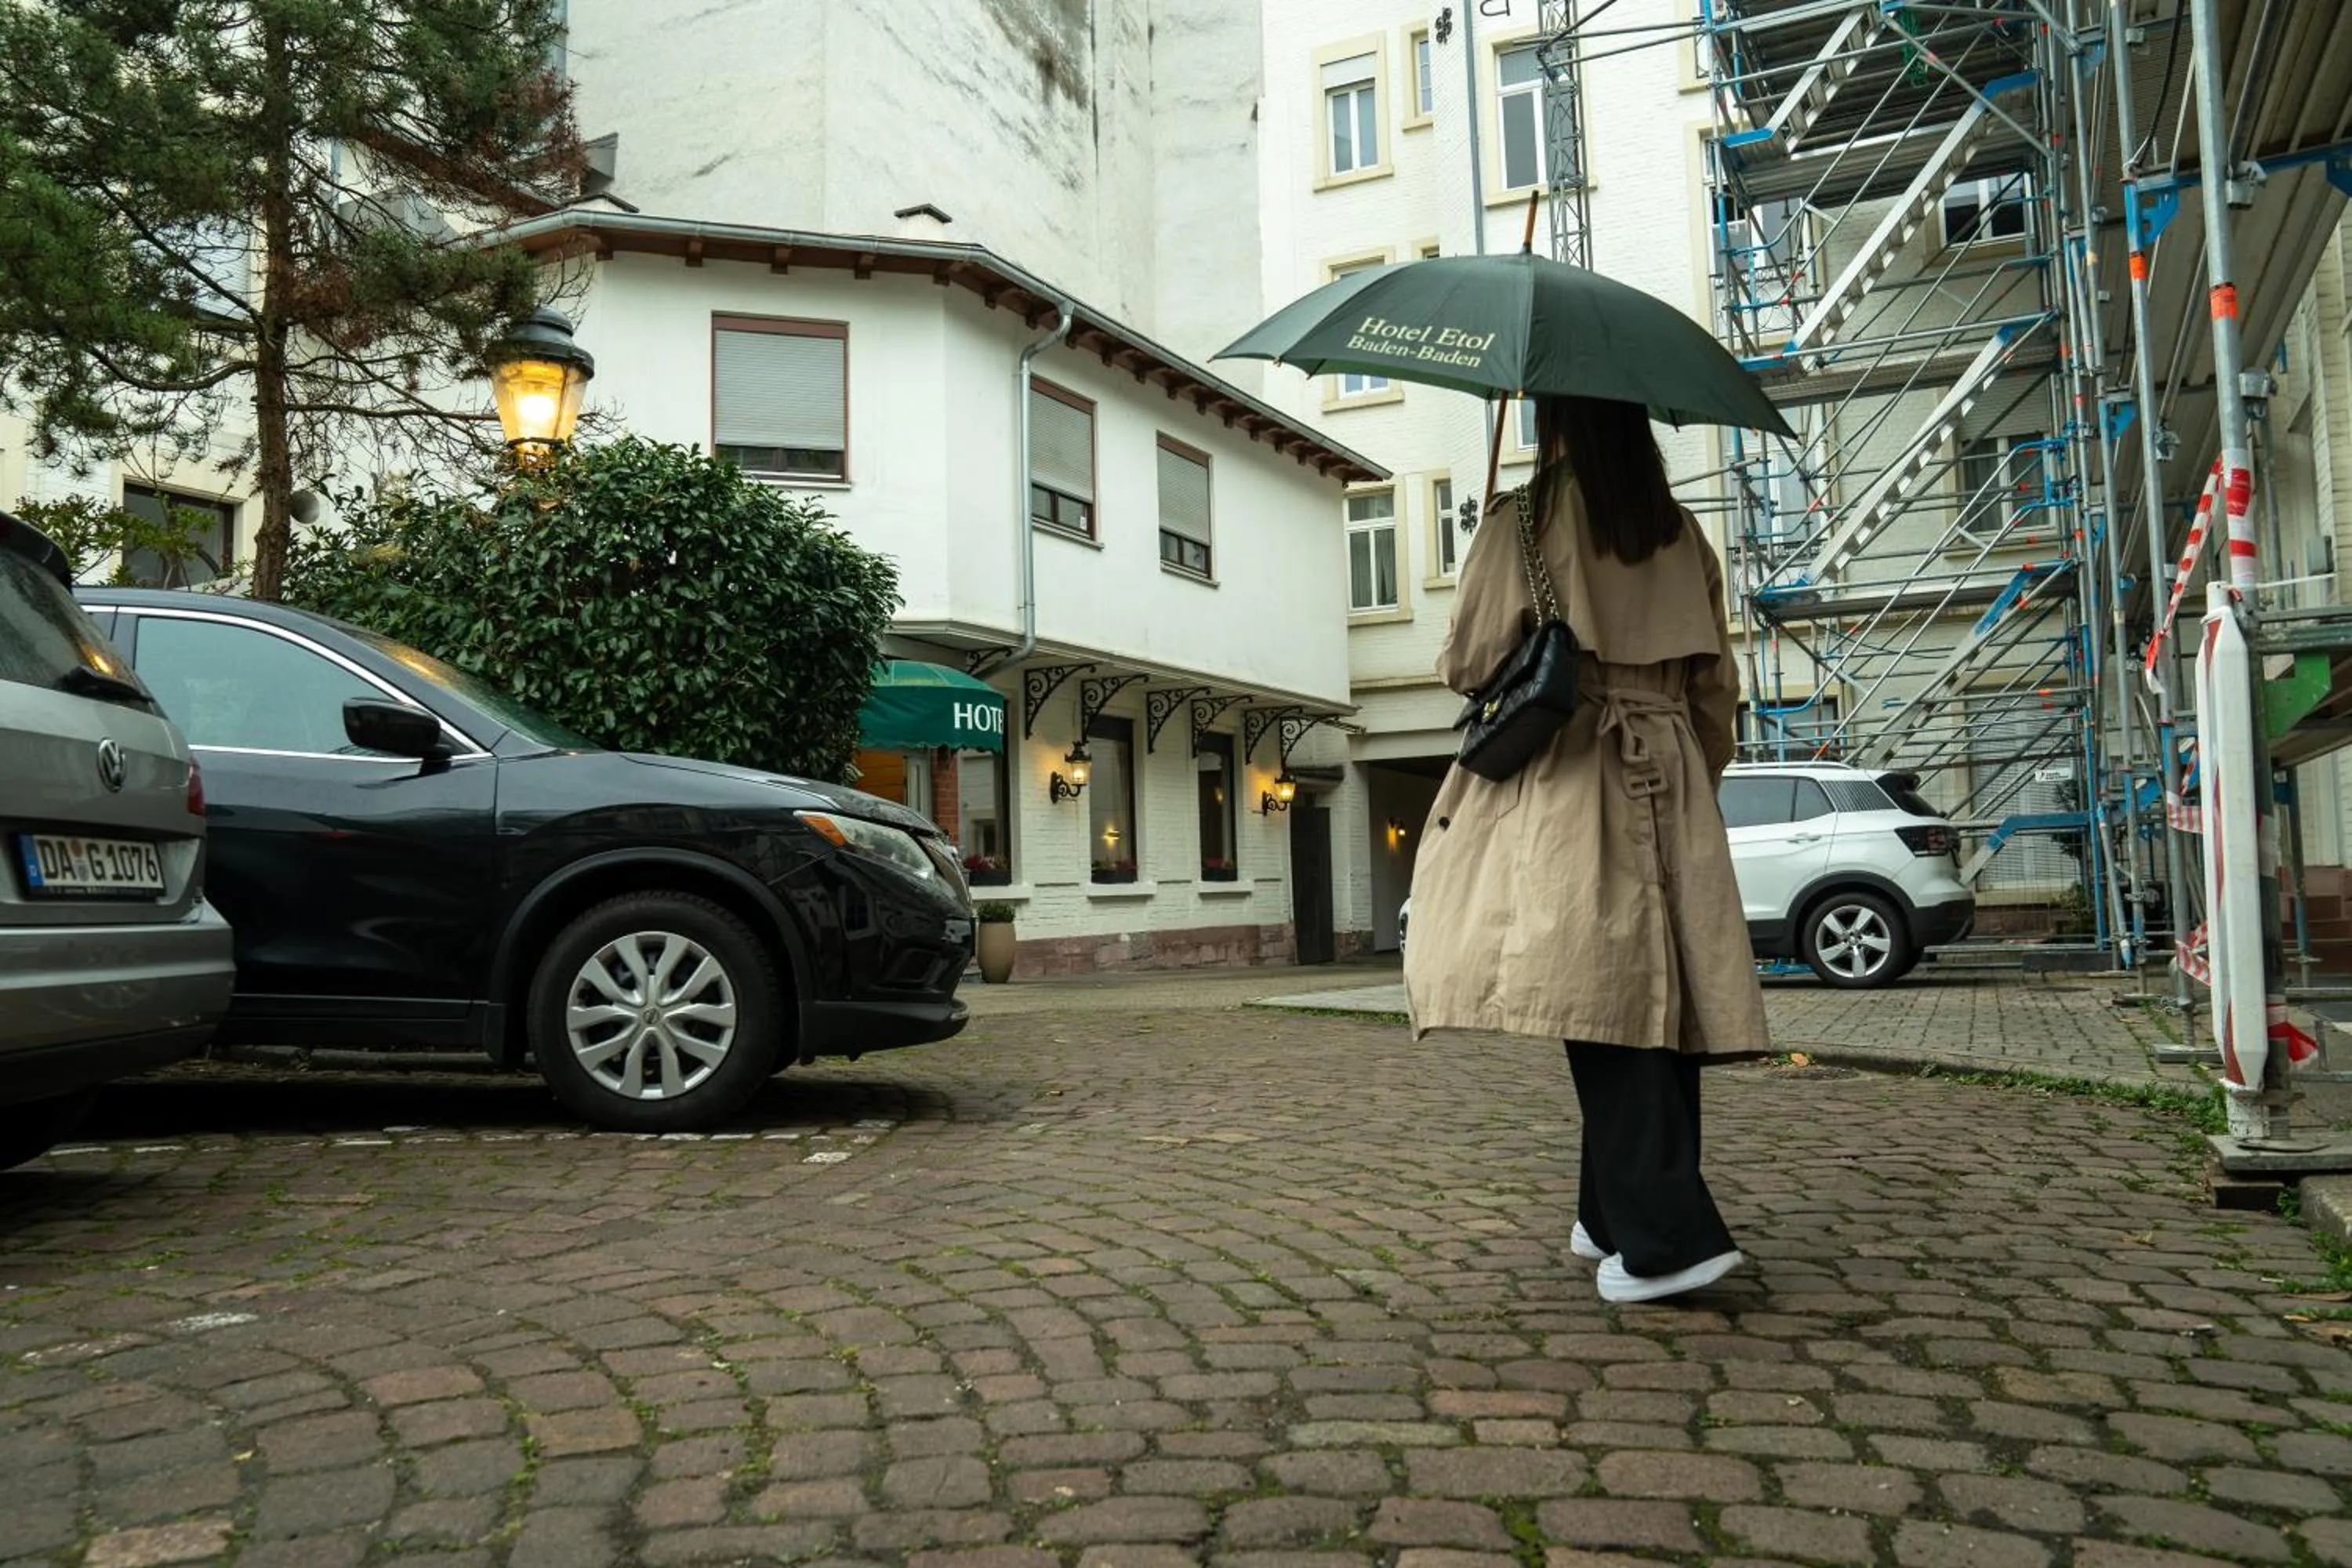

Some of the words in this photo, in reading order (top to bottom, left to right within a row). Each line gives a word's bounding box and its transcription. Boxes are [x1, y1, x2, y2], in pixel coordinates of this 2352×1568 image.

[1358, 317, 1432, 343] Hotel
[1435, 326, 1496, 350] Etol
[1346, 335, 1481, 368] Baden-Baden
[953, 702, 1004, 735] HOTE
[37, 839, 77, 880] DA
